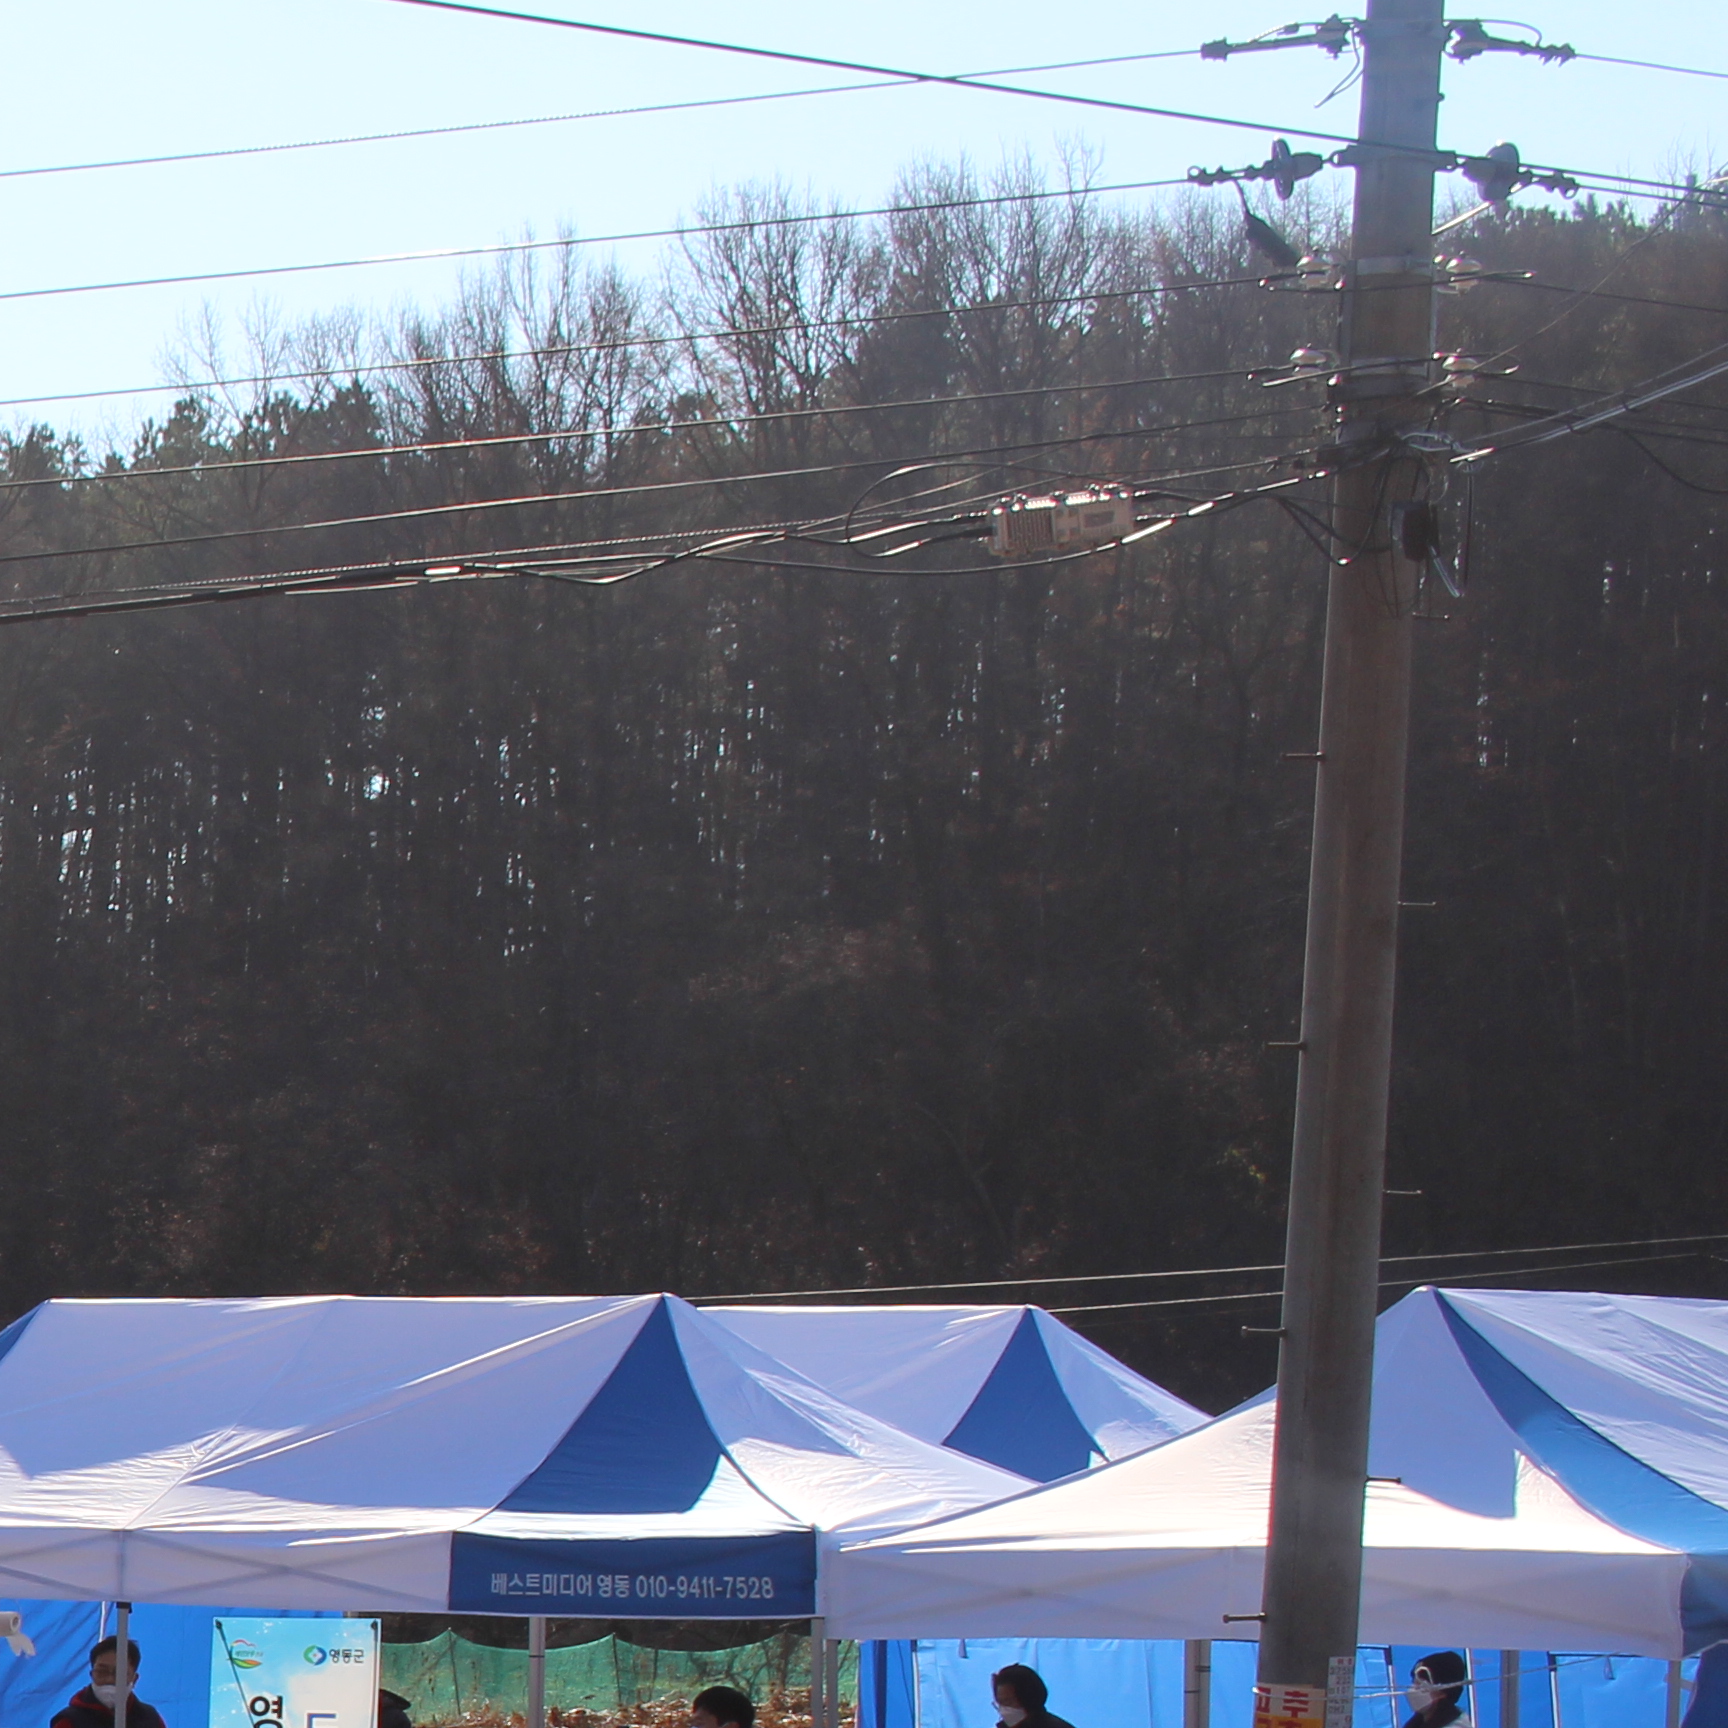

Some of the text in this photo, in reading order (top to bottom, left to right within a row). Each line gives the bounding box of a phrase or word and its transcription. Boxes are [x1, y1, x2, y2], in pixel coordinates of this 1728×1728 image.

[490, 1572, 775, 1600] 베스트미디어 영동 010-9411-7528
[329, 1648, 365, 1664] 영동군
